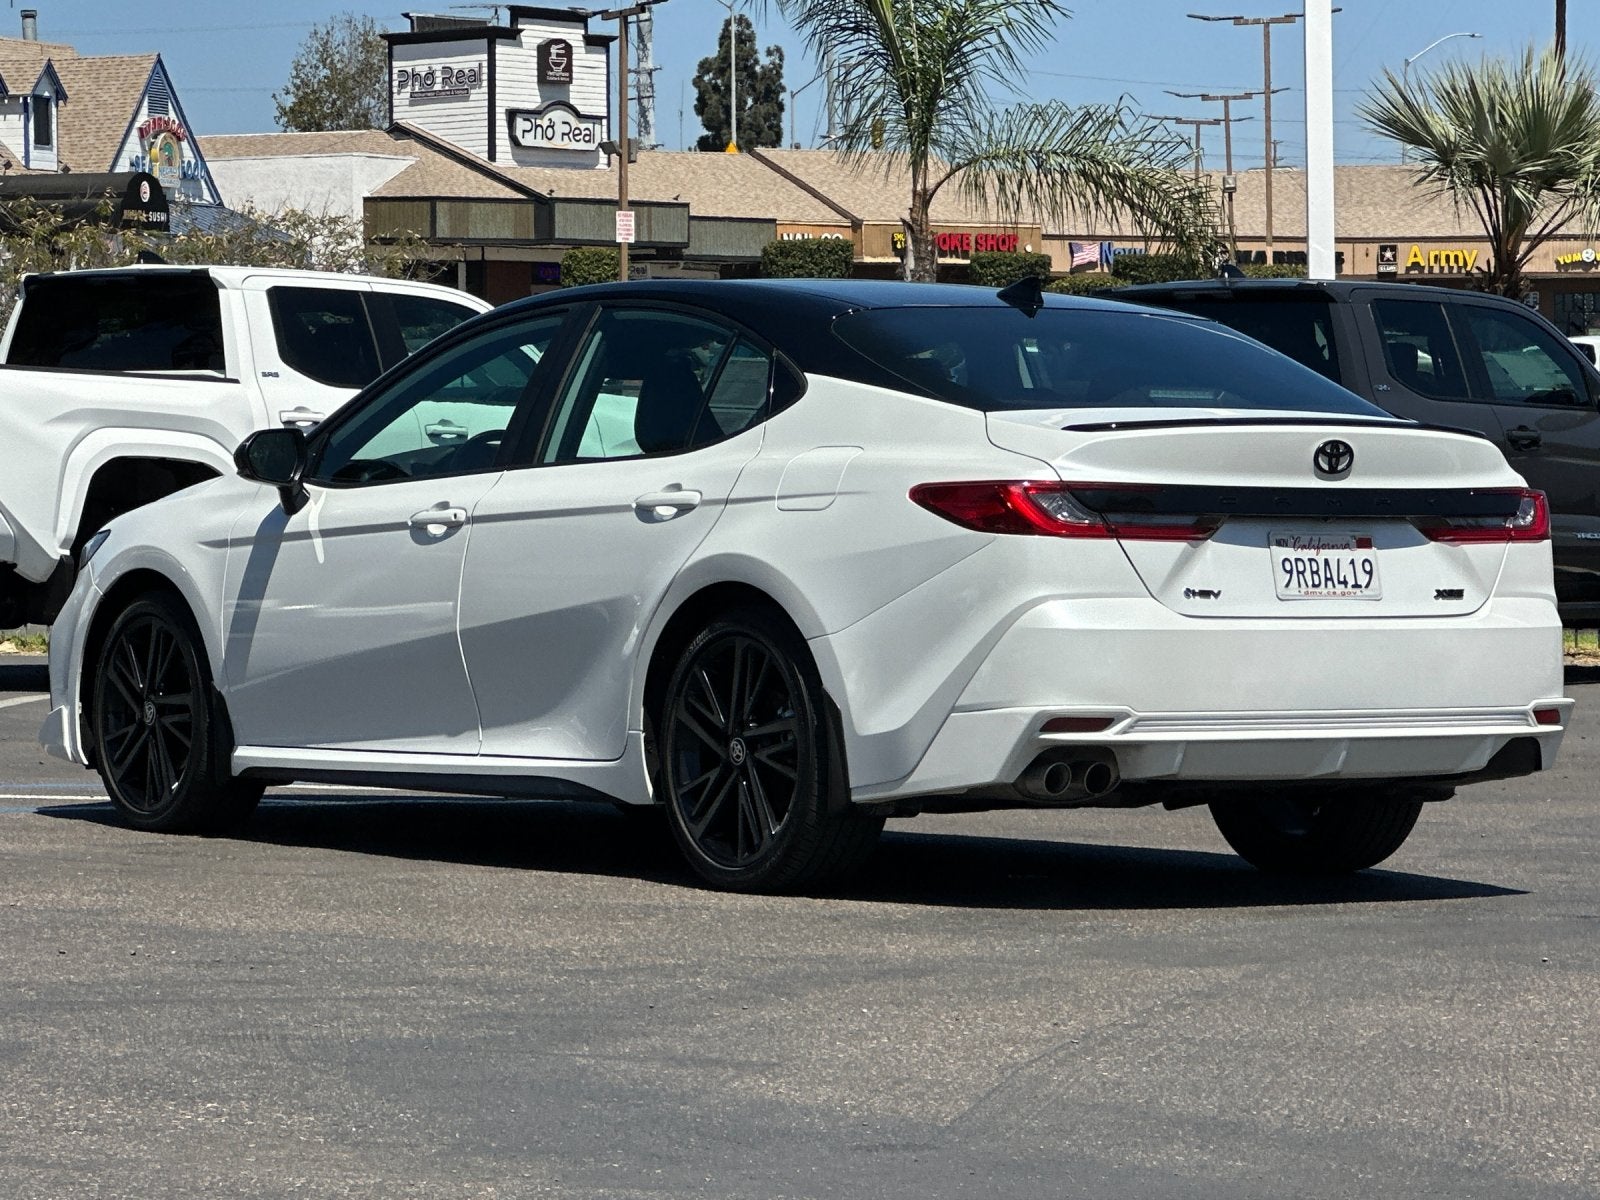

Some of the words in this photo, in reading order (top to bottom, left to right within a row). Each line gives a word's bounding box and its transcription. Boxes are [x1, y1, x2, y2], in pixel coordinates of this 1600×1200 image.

[441, 62, 483, 86] Real
[562, 122, 595, 144] Real
[149, 211, 167, 222] SUSHI
[975, 233, 1019, 252] SHOP
[1406, 244, 1478, 272] Army
[1291, 535, 1351, 556] California
[1281, 557, 1374, 589] 9RBA419
